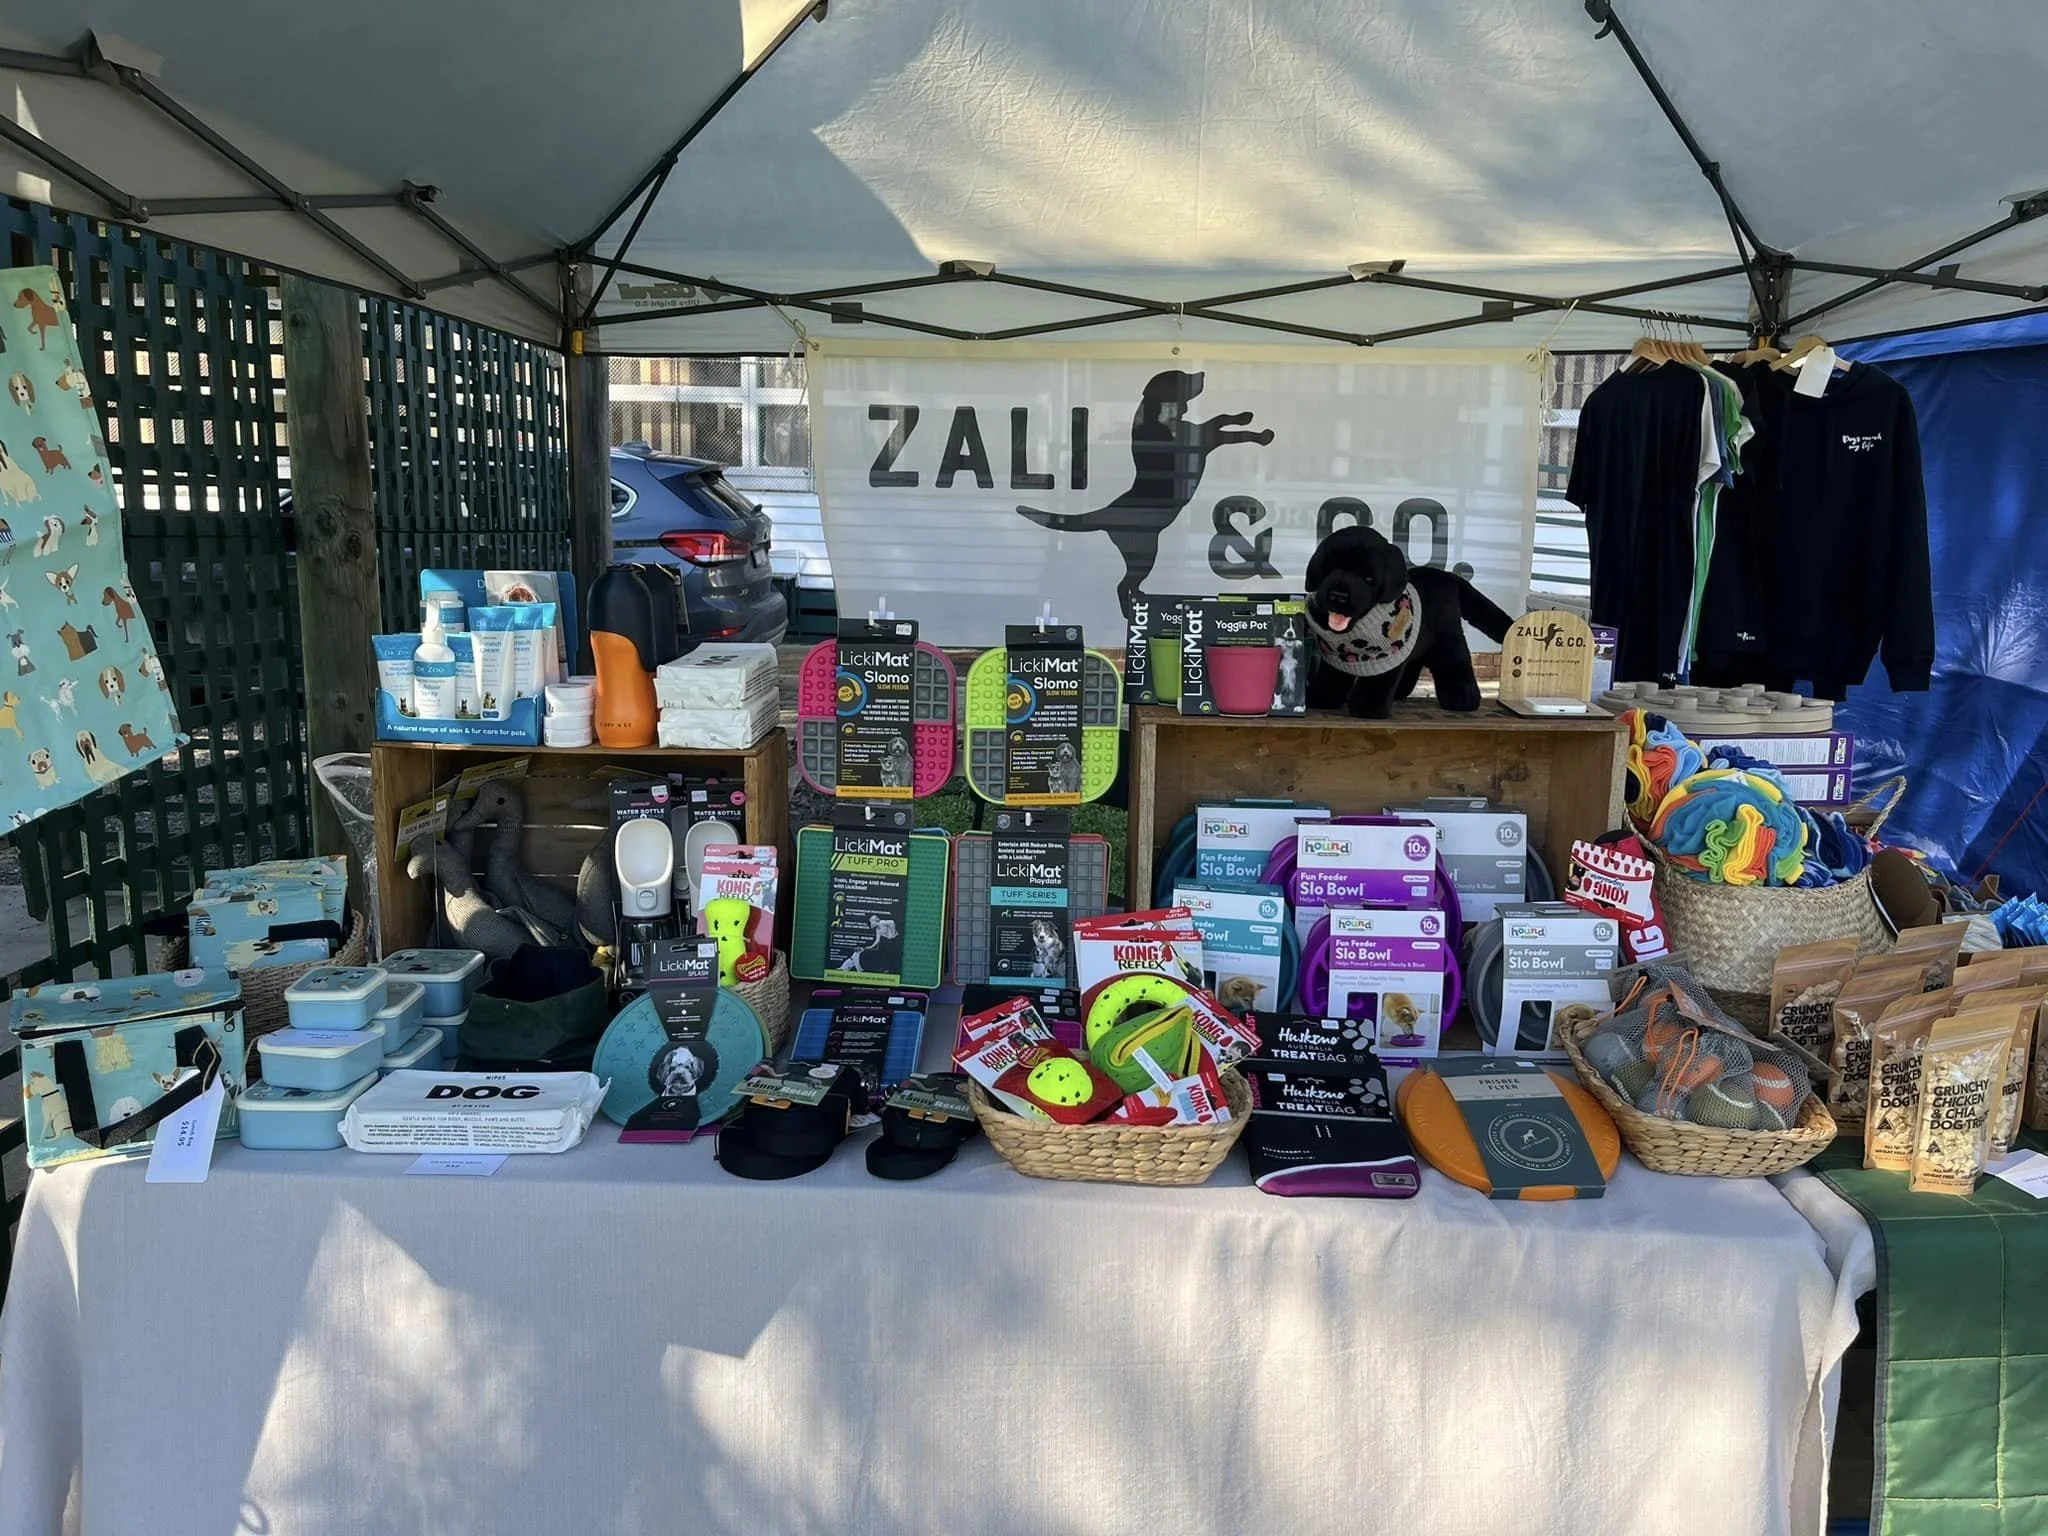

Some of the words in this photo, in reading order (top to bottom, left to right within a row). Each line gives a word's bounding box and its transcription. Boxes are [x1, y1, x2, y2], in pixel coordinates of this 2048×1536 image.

[868, 404, 1089, 489] ZALI
[1208, 494, 1283, 580] &
[1161, 612, 1182, 623] Yogg
[1215, 619, 1248, 633] Yoggie
[1250, 621, 1268, 630] Pot
[1517, 626, 1543, 637] ZALI
[1126, 602, 1148, 686] LickiMat
[1555, 637, 1564, 647] &
[1567, 637, 1586, 647] CO.
[840, 650, 909, 668] LickiMat
[1184, 610, 1203, 696] LickiMat
[1010, 657, 1078, 673] LickiMat
[864, 670, 909, 684] Slomo
[1033, 677, 1078, 690] Slomo
[419, 726, 438, 734] range
[1204, 820, 1248, 835] hound
[1499, 828, 1518, 840] 10x
[835, 836, 902, 855] LickiMat
[1304, 838, 1349, 853] hound
[1407, 842, 1427, 853] 10x
[847, 856, 873, 865] TUFF
[876, 858, 899, 867] PRO
[1200, 853, 1215, 862] Fun
[1218, 854, 1246, 863] Feeder
[997, 863, 1062, 878] LickiMat
[1200, 863, 1223, 876] Slo
[1226, 863, 1262, 877] Bowl
[1300, 872, 1316, 880] Fun
[1318, 873, 1348, 881] Feeder
[717, 880, 751, 895] KONG
[1030, 877, 1061, 885] Playdate
[1027, 891, 1056, 899] SERIES
[1300, 882, 1324, 896] Slo
[1327, 883, 1364, 896] Bowl
[1593, 881, 1629, 905] KONG
[1179, 897, 1211, 910] hound
[1261, 904, 1275, 914] 10x
[1194, 920, 1215, 928] eeder
[1339, 919, 1371, 930] hound
[1422, 920, 1437, 930] 10x
[1200, 929, 1229, 942] Bowl
[1511, 926, 1545, 937] hound
[1596, 927, 1610, 936] 10x
[1335, 939, 1349, 947] Fun
[1114, 945, 1158, 961] KONG
[1336, 948, 1356, 960] Slo
[1359, 949, 1391, 960] Bowl
[660, 959, 709, 972] LickiMat
[1118, 958, 1166, 971] REFLEX
[1508, 957, 1529, 968] Slo
[1532, 957, 1564, 968] Bowl
[1782, 1000, 1833, 1015] CRUNCHY
[836, 1015, 887, 1024] LickiMat
[1193, 1009, 1225, 1038] KONG
[1781, 1015, 1829, 1025] CHICKEN
[1278, 1027, 1340, 1045] Huskimo
[1791, 1025, 1818, 1035] CHIA
[1288, 1043, 1332, 1051] AUSTRALIA
[1790, 1036, 1807, 1045] OG
[979, 1044, 1013, 1068] KONG
[1271, 1049, 1346, 1063] TREATBAG
[1478, 1077, 1520, 1085] FRISBEE
[1934, 1079, 1990, 1096] CRUNCHY
[426, 1085, 540, 1099] DOG
[1282, 1084, 1346, 1100] Huskimo
[1880, 1086, 1891, 1097] &
[1894, 1084, 1917, 1096] CHIA
[1186, 1084, 1209, 1118] KONG
[1880, 1097, 1910, 1108] DOG
[1933, 1092, 1985, 1108] CHICKEN
[1276, 1102, 1355, 1114] TREATBAG
[1931, 1110, 1941, 1119] &
[1945, 1107, 1976, 1119] CHIA
[1930, 1120, 1963, 1130] DOG
